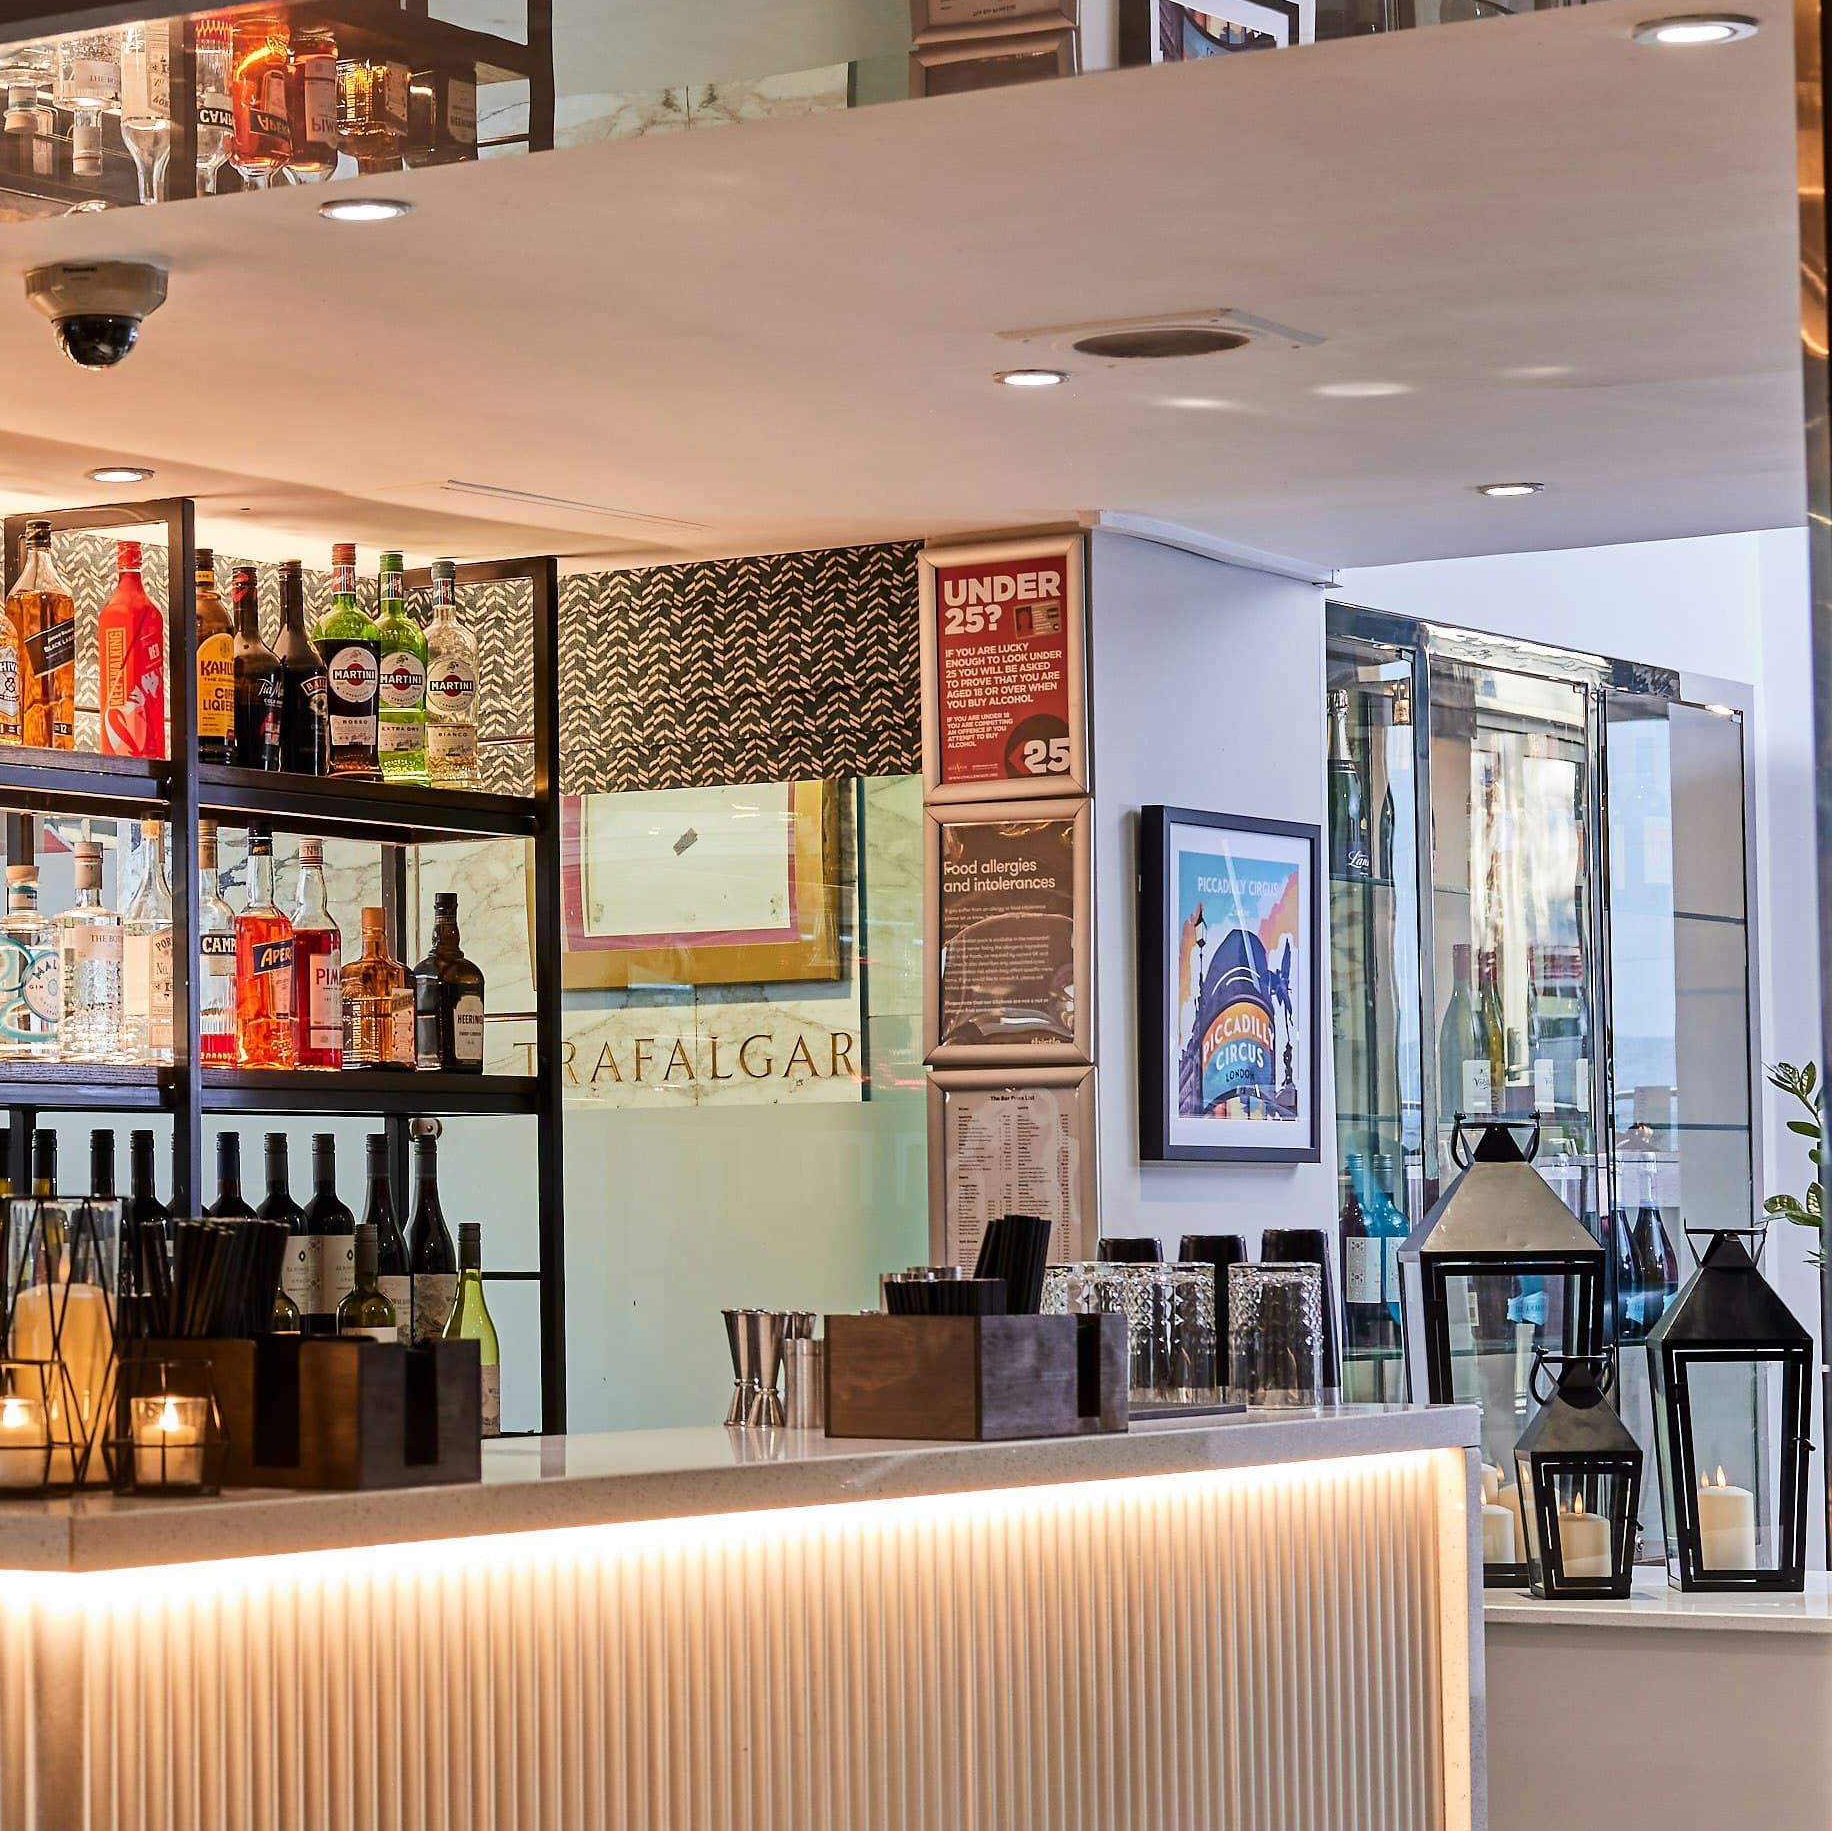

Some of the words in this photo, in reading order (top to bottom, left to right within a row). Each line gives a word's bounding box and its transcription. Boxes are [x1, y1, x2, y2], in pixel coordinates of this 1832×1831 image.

[944, 570, 1061, 606] UNDER
[944, 604, 1002, 635] 25?
[109, 631, 124, 679] WALKING
[148, 643, 160, 660] RED
[945, 649, 954, 658] IF
[956, 647, 975, 658] YOU
[977, 645, 996, 655] ARE
[998, 642, 1029, 653] LUCKY
[946, 658, 985, 668] ENOUGH
[987, 656, 1000, 665] TO
[1002, 653, 1028, 663] LOOK
[1030, 650, 1062, 661] UNDER
[334, 669, 375, 680] MARTINI
[946, 668, 957, 679] 25
[959, 666, 978, 677] YOU
[980, 665, 1004, 675] WILL
[1005, 664, 1018, 673] BE
[1019, 661, 1051, 672] ASKED
[380, 674, 422, 685] MARTINI
[431, 681, 472, 691] MARTINI
[946, 679, 959, 689] TO
[961, 676, 992, 687] PROVE
[994, 674, 1018, 685] THAT
[1019, 672, 1039, 682] YOU
[1040, 671, 1061, 680] ARE
[946, 689, 972, 699] AGED
[973, 687, 983, 697] 18
[984, 686, 999, 696] OR
[1000, 684, 1027, 694] OVER
[1028, 682, 1058, 692] WHEN
[946, 699, 966, 710] YOU
[968, 697, 987, 708] BUY
[989, 693, 1034, 706] ALCOHOL
[958, 727, 986, 735] OFFENCE
[974, 718, 1013, 727] COMMITTING
[948, 735, 976, 743] ATTEMPT
[948, 741, 976, 749] ALCOHOL
[1023, 737, 1071, 774] 25
[943, 859, 978, 876] Food
[981, 857, 1037, 876] allergies
[943, 877, 970, 893] and
[974, 875, 1056, 892] intolerances
[1248, 880, 1278, 898] CIRCUS
[90, 934, 106, 942] THE
[457, 1014, 484, 1025] HEERING
[1202, 1014, 1275, 1063] PICCADILLY
[1215, 1042, 1265, 1071] CIRCUS
[1225, 1069, 1256, 1082] LONDON
